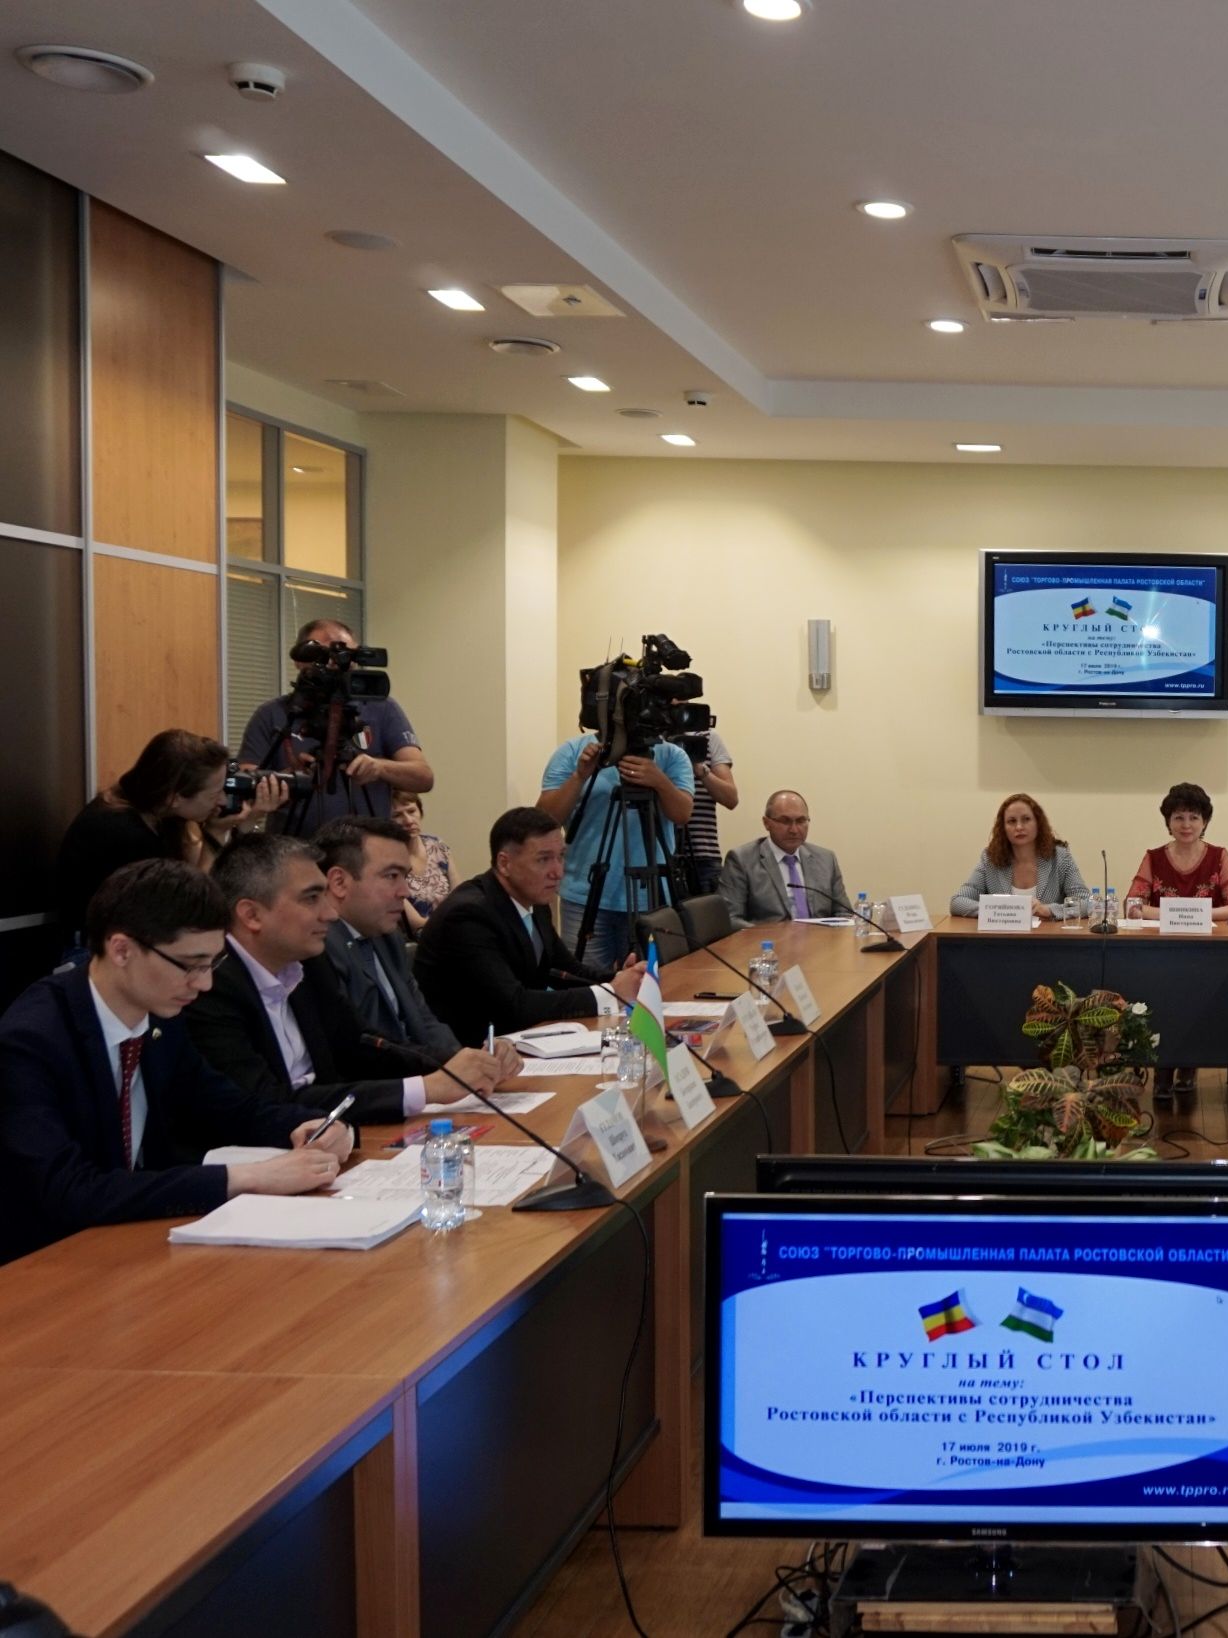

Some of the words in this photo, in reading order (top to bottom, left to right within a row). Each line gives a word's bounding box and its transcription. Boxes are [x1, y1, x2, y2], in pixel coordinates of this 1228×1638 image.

[1043, 623, 1112, 633] КРУГЛЫЙ
[779, 1246, 820, 1260] СОЮЗ
[824, 1246, 1015, 1261] "ТОРГОВО-ПРОМЫШЛЕННАЯ
[1019, 1248, 1070, 1261] ПАЛАТА
[1074, 1246, 1164, 1262] РОСТОВСКОЙ
[853, 1350, 1014, 1370] КРУГЛЫЙ
[1037, 1353, 1124, 1370] СТОЛ
[958, 1379, 975, 1388] на
[980, 1379, 1024, 1390] тему:
[850, 1390, 982, 1407] «Перспективы
[988, 1394, 1133, 1408] сотрудничества
[767, 1407, 872, 1422] Ростовской
[879, 1409, 951, 1423] области
[958, 1412, 967, 1422] с
[975, 1410, 1093, 1427] Республикой
[1101, 1410, 1216, 1426] Узбекистан»
[942, 1442, 956, 1452] 17
[960, 1444, 990, 1452] июля
[997, 1442, 1027, 1453] 2019
[1031, 1445, 1040, 1453] г.
[936, 1457, 946, 1466] г.
[950, 1456, 1045, 1468] Ростов-на-Дону
[972, 1528, 1007, 1536] SAMSUNG
